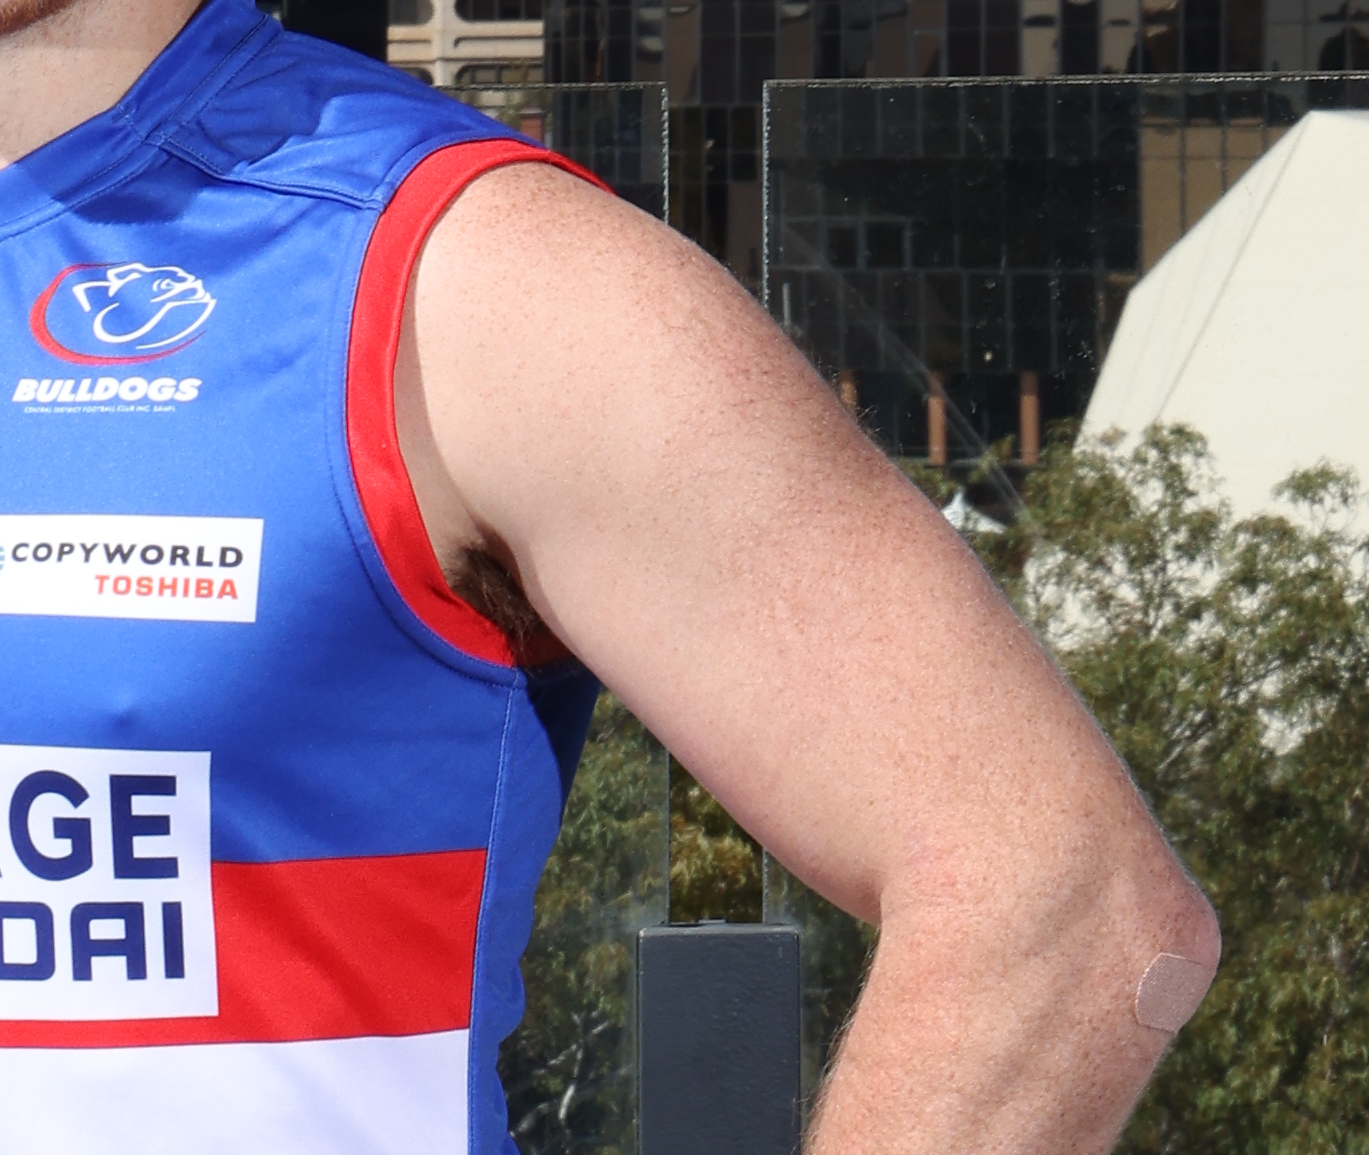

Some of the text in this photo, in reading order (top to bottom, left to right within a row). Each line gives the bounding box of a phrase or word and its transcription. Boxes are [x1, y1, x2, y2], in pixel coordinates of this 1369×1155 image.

[11, 376, 203, 403] BULLDOGS
[11, 542, 244, 568] COPYWORLD
[94, 574, 239, 600] TOSHIBA
